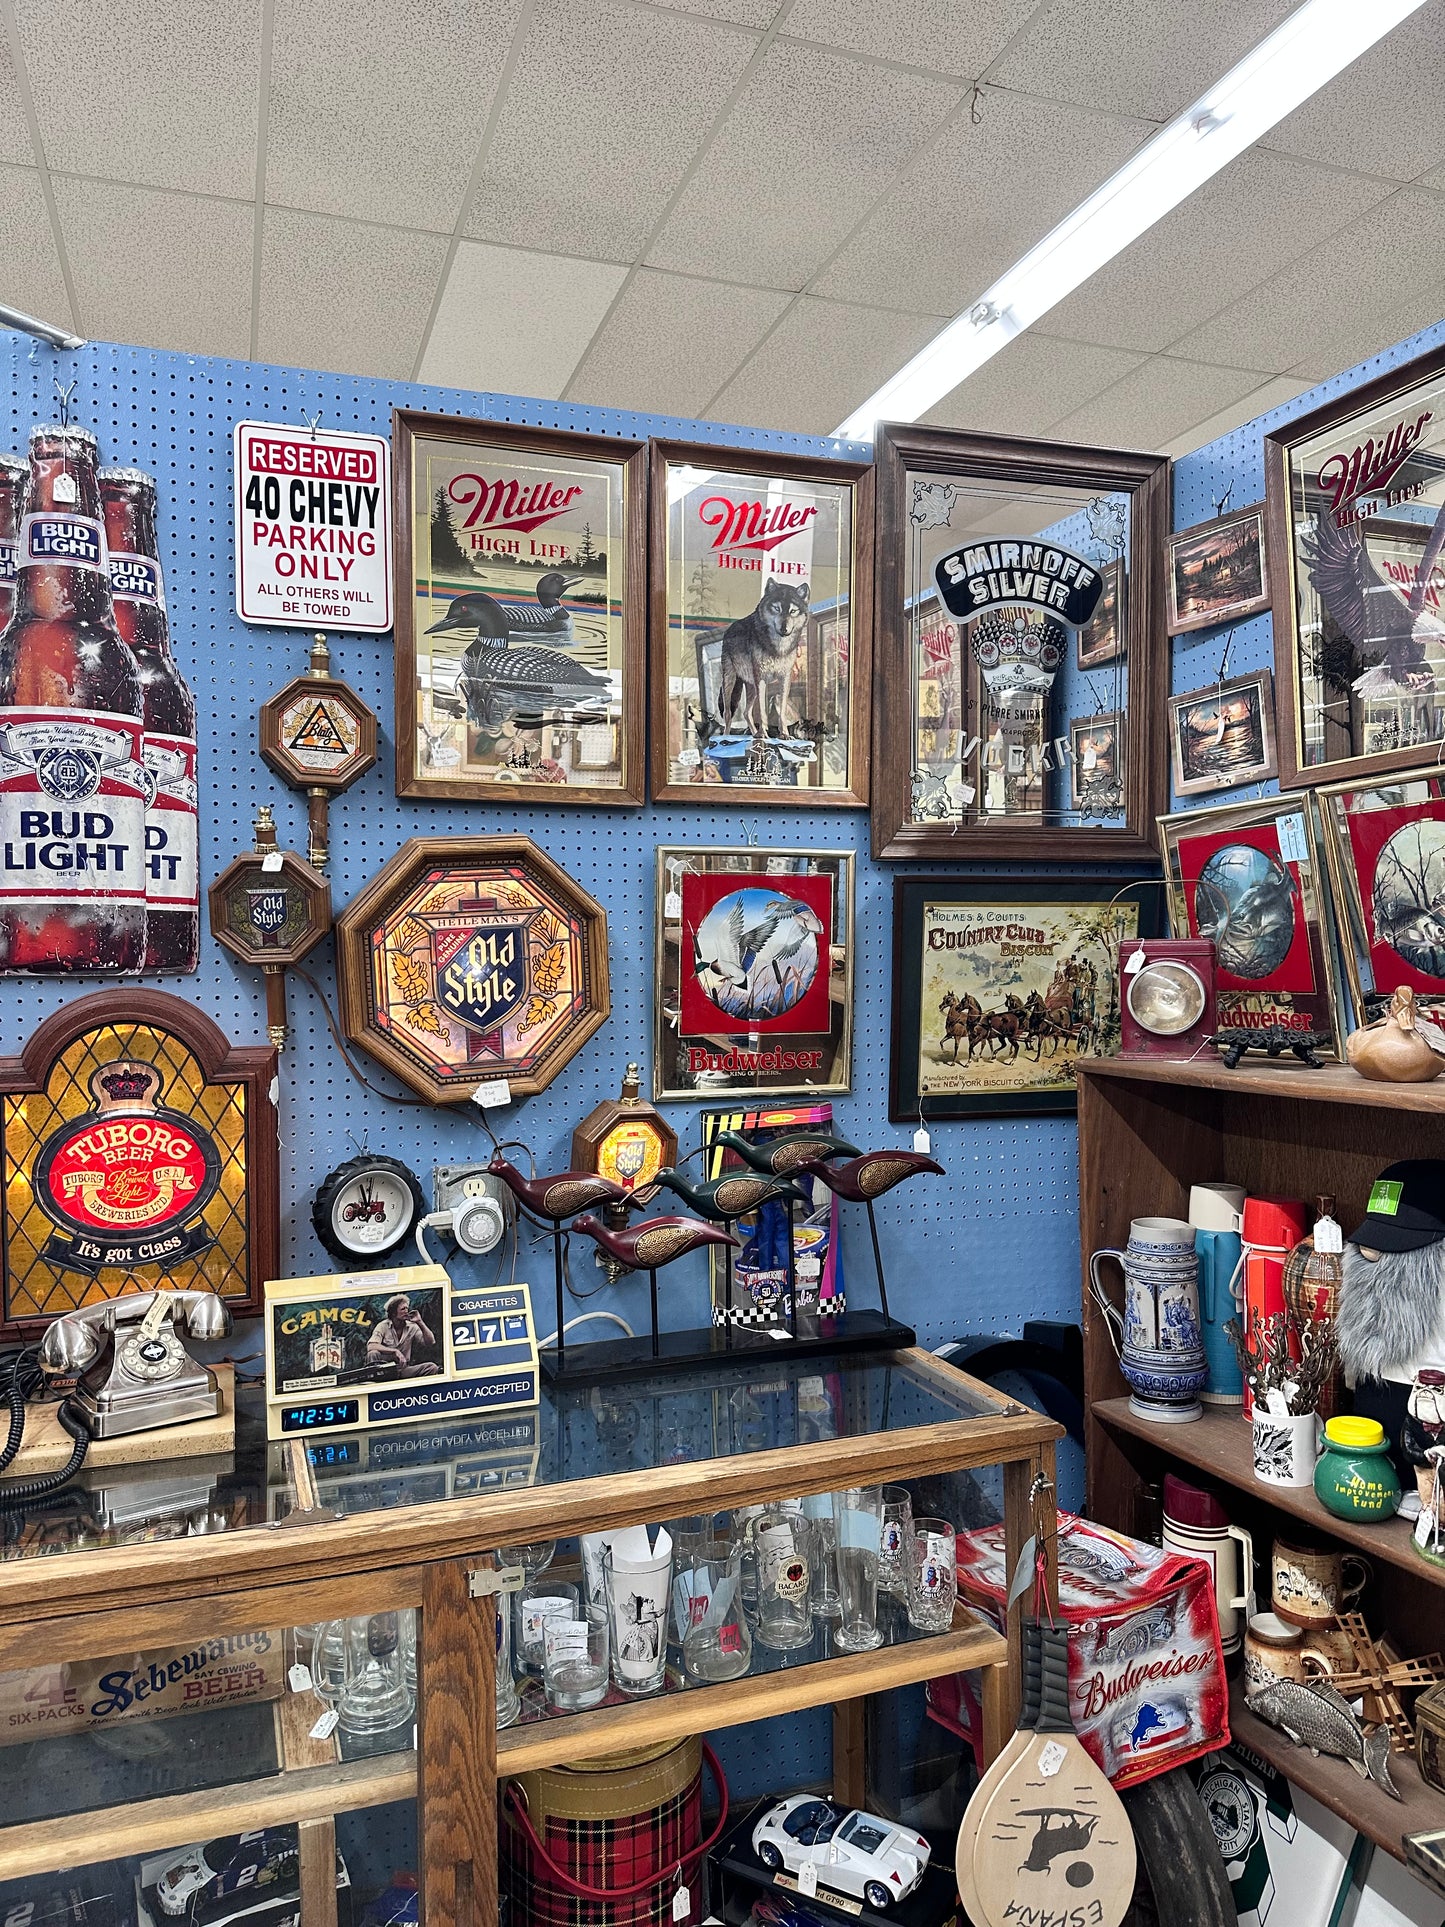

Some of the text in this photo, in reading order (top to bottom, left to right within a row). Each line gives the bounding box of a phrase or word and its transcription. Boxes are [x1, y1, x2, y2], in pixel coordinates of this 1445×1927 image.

[252, 442, 374, 478] RESERVED
[1317, 410, 1434, 514] Miller
[246, 475, 380, 529] 40 CHEVY
[449, 473, 584, 530] Miller
[1336, 480, 1426, 530] HIGH LIFE
[42, 524, 90, 540] BUD
[699, 496, 818, 548] Miller
[33, 538, 98, 558] LIGHT
[253, 522, 376, 556] PARKING
[470, 533, 571, 559] HIGH LIFE
[275, 552, 355, 582] ONLY
[718, 552, 762, 572] HIGH
[944, 543, 1096, 590] SMIRNOFF
[111, 575, 156, 594] GHT
[258, 583, 374, 603] ALL OTHERS WILL
[972, 571, 1068, 611] SILVER
[282, 601, 350, 617] BE TOWED
[982, 704, 1010, 720] PIERRE
[956, 730, 1079, 773] VODKA
[20, 811, 114, 839] BUD
[5, 842, 129, 871] LIGHT
[264, 896, 282, 911] Old
[254, 907, 283, 929] Style
[438, 915, 519, 927] HEILEMAN'S
[932, 912, 1025, 923] HOLMES & COUTTS
[438, 932, 456, 952] PURE
[438, 931, 467, 964] GENUINE
[928, 924, 1046, 951] COUNTRY CLUB
[1000, 942, 1056, 956] BISCUIT
[468, 932, 515, 968] Old
[444, 966, 517, 1018] Style
[1217, 1005, 1314, 1030] udweiser
[687, 1046, 822, 1072] Budweiser
[962, 1080, 982, 1089] YORK
[984, 1079, 1012, 1087] BISCUIT
[66, 1124, 192, 1164] TUBORG
[626, 1144, 642, 1156] Old
[104, 1146, 154, 1166] BEER
[618, 1157, 642, 1174] Style
[64, 1173, 104, 1186] TUBORG
[108, 1166, 149, 1191] Brewed
[154, 1168, 183, 1181] U.S.A.
[106, 1186, 150, 1205] Light
[88, 1196, 170, 1221] BREWERIES LTD.
[78, 1234, 182, 1263] It's got Class
[458, 1297, 518, 1310] CIGARETTES
[762, 1288, 770, 1296] 50
[281, 1308, 372, 1335] CAMEL
[482, 1324, 496, 1342] 7
[373, 1380, 530, 1412] COUPONS GLADLY ACCEPTED
[300, 1404, 348, 1424] 12:54
[1350, 1476, 1383, 1492] Home
[1353, 1496, 1382, 1509] Fund
[194, 1662, 256, 1680] SAY CBWING
[183, 1668, 268, 1700] BEER
[1076, 1649, 1214, 1720] Budweiser
[9, 1704, 84, 1726] SIX-PACKS
[1204, 1779, 1240, 1802] MICHIGAN
[1242, 1802, 1250, 1834] STATE
[236, 1864, 258, 1888] 2
[826, 1894, 844, 1906] GT90
